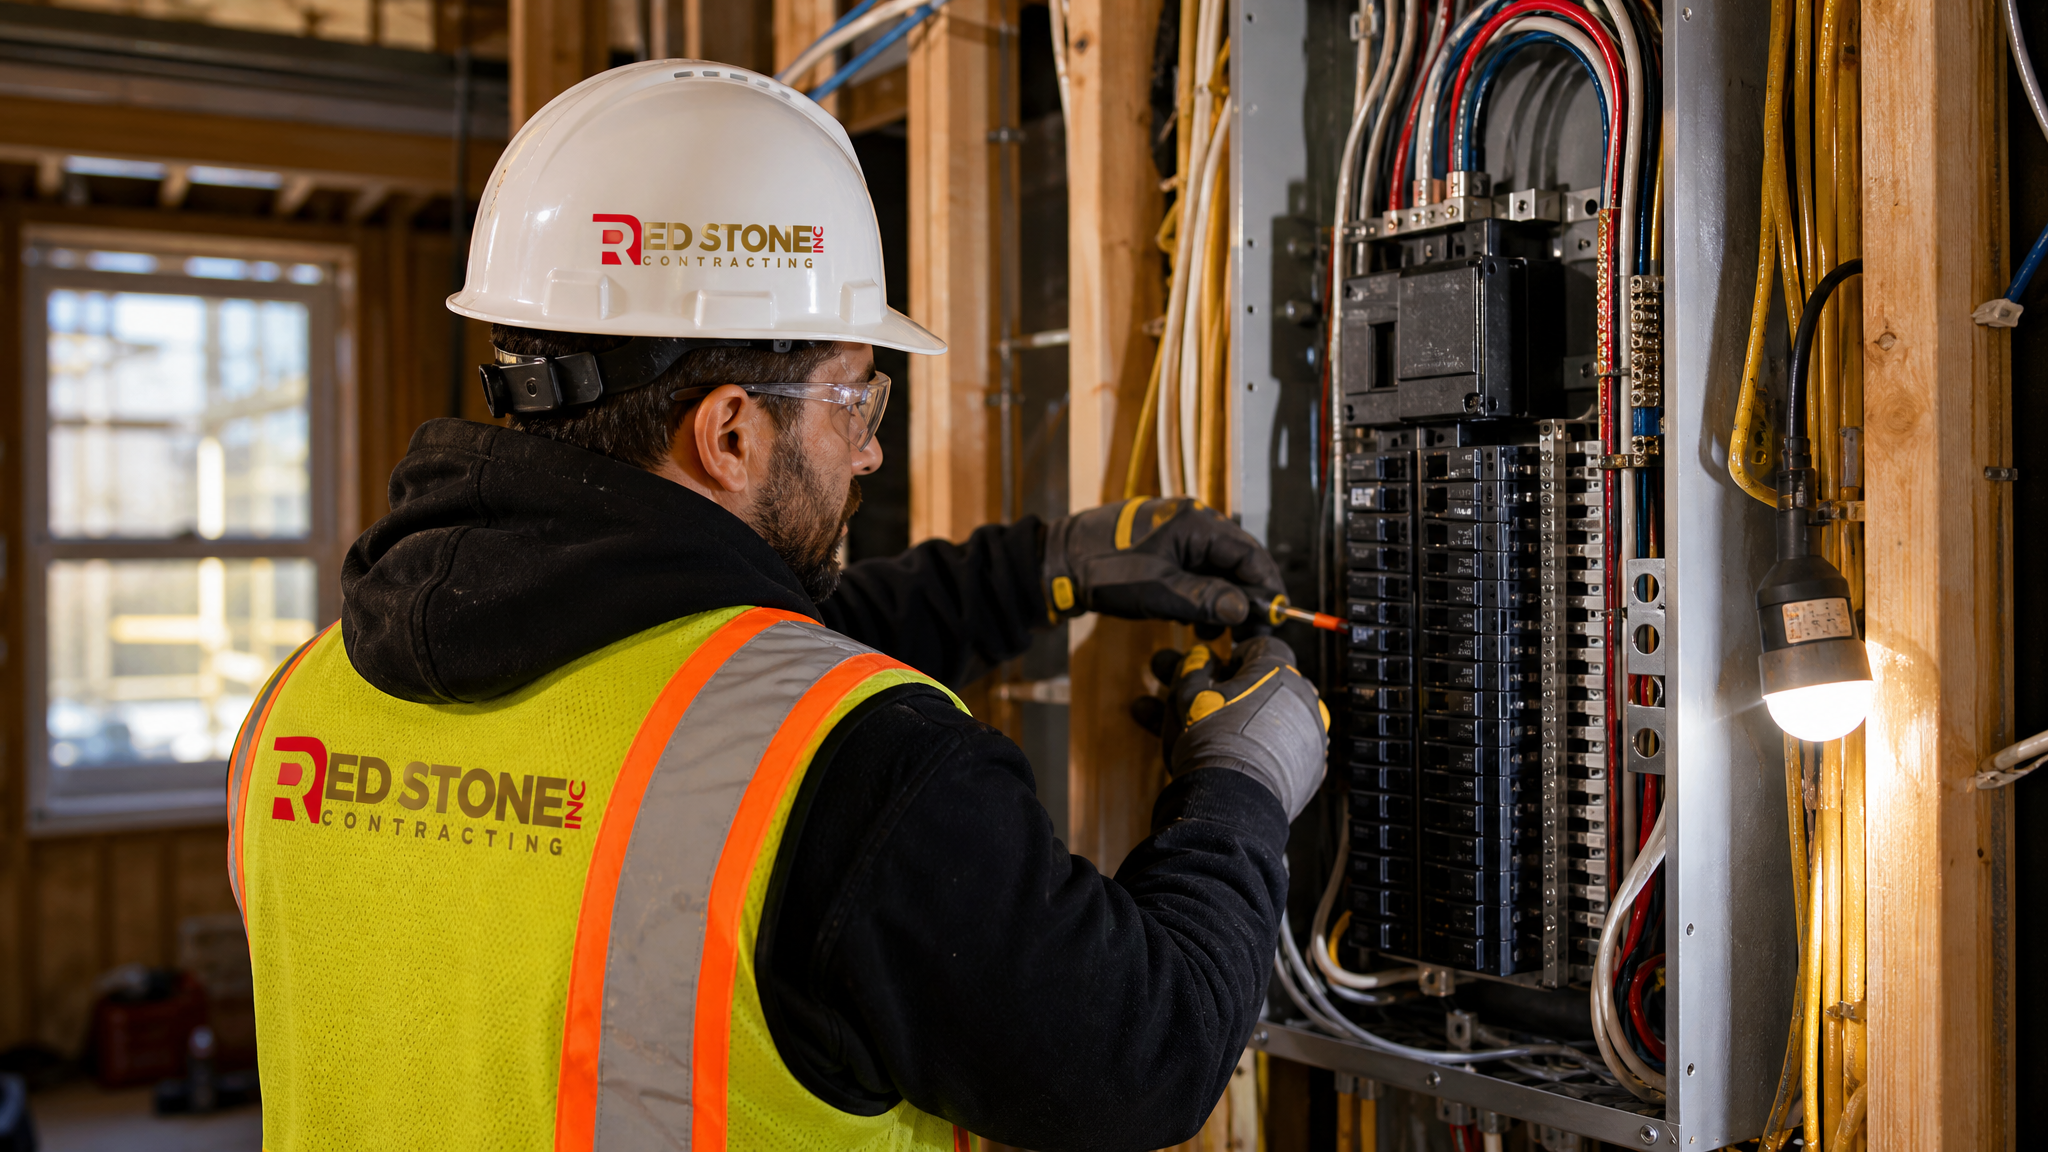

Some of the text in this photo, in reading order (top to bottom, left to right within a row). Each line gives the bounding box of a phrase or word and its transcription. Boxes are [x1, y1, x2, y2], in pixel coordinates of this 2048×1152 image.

[592, 213, 813, 266] RED STONE
[642, 255, 814, 269] CONTRACTING
[812, 225, 824, 254] INC
[271, 735, 568, 829] RED STONE
[563, 779, 586, 830] INC
[321, 809, 563, 856] CONTRACTING
